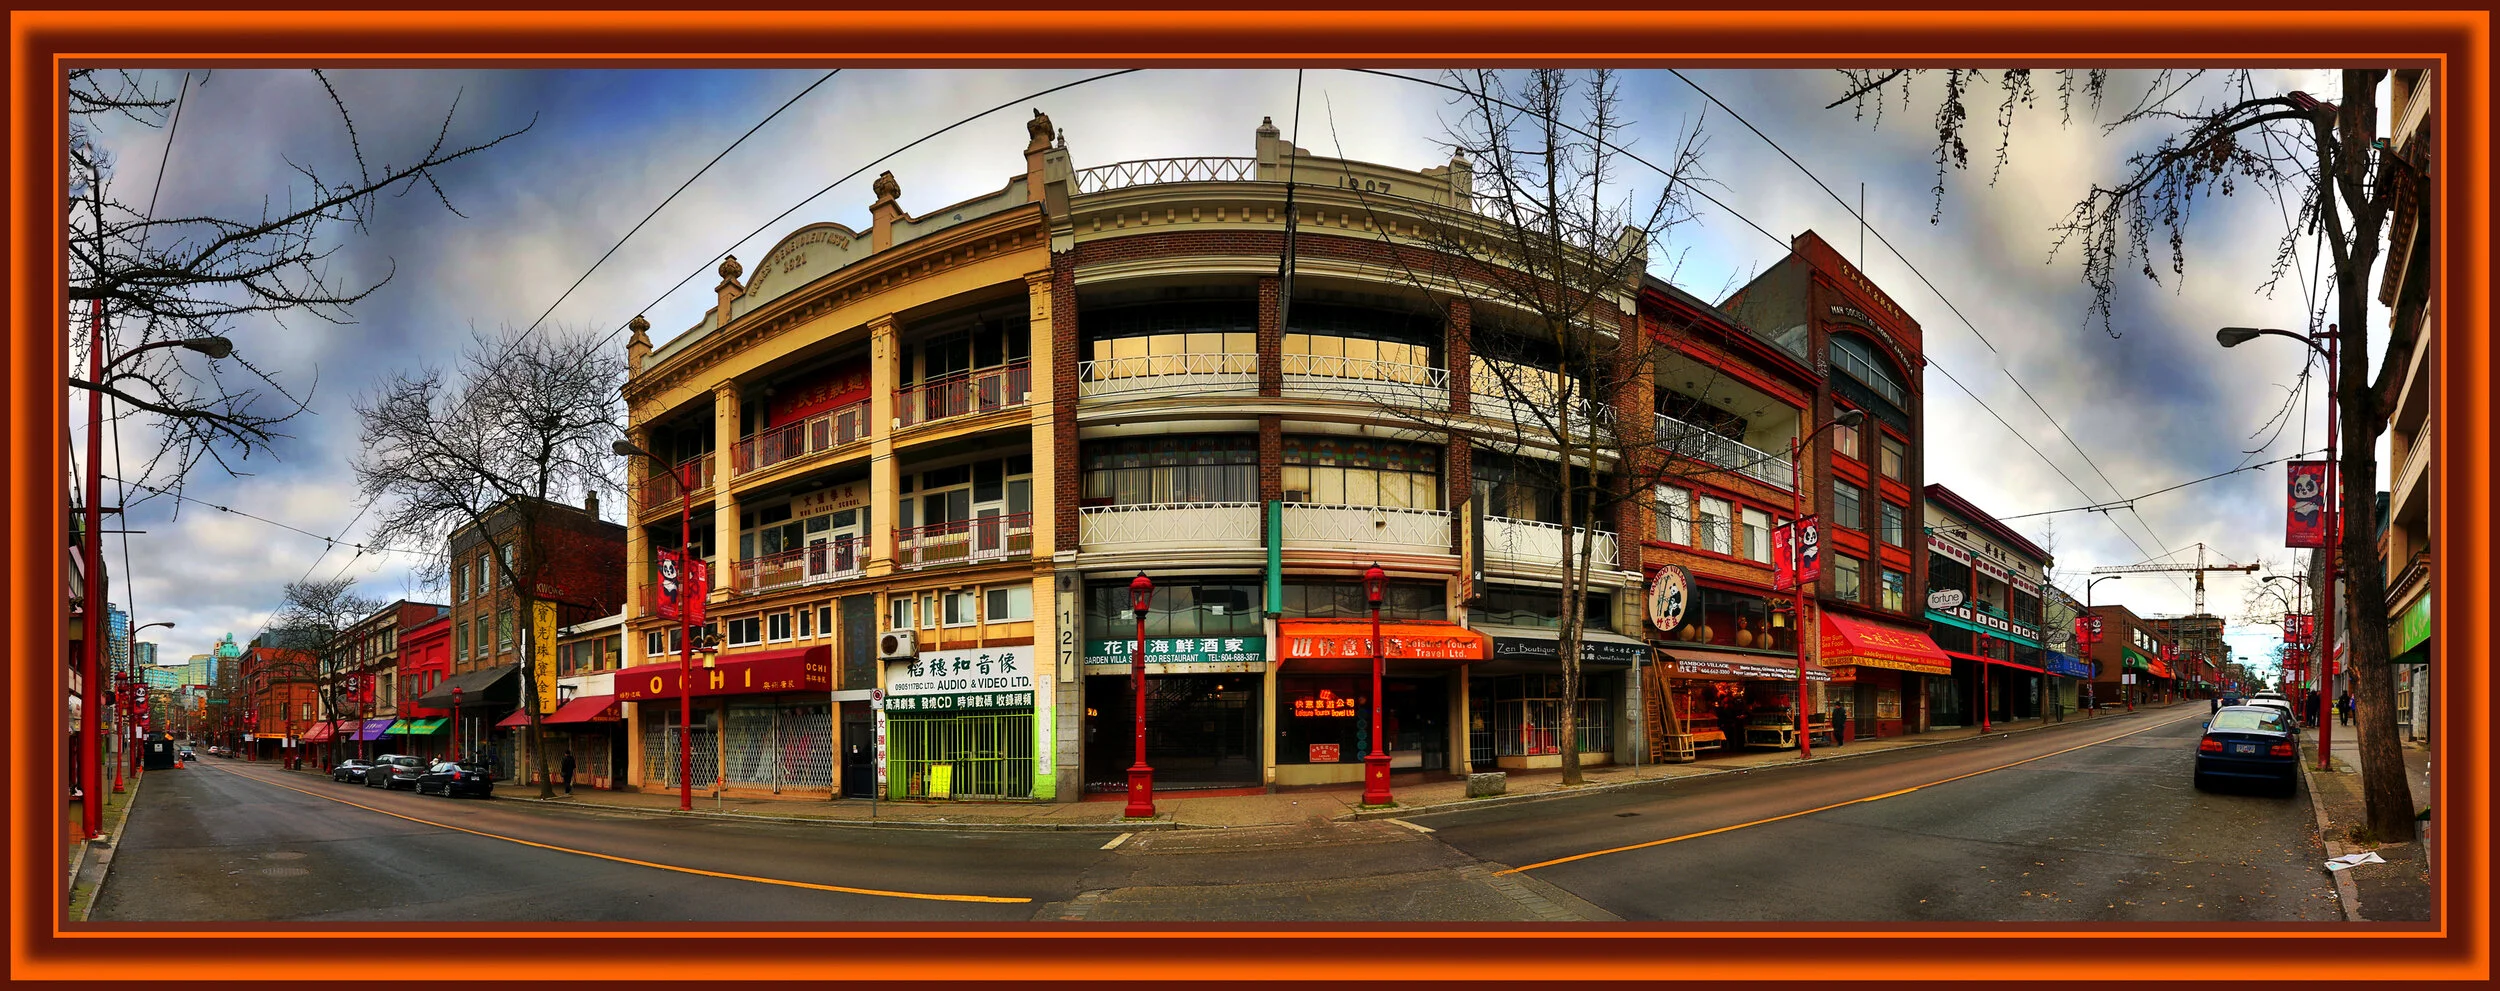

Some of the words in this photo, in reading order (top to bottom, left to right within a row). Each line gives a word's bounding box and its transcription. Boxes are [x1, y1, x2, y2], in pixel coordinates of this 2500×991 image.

[773, 232, 827, 265] BENEVOLENT
[783, 251, 807, 274] 1921
[1845, 307, 1868, 323] SOCIETY
[1868, 318, 1876, 328] OF
[1877, 325, 1893, 345] NORTH
[1893, 345, 1913, 376] AMERICA
[838, 498, 860, 509] SCHOOL
[1650, 566, 1669, 596] BAMBOO
[1670, 565, 1687, 591] VILLAGE
[1931, 593, 1959, 604] fortune
[1062, 610, 1073, 665] 127
[1415, 649, 1445, 658] Travel
[1449, 649, 1468, 658] Ltd.
[1497, 643, 1516, 654] Zen
[1519, 643, 1556, 656] Boutique
[1084, 656, 1109, 665] GARDEN
[1109, 655, 1127, 664] VILLA
[1128, 654, 1158, 664] SOOD
[1158, 653, 1199, 663] RESTAURANT
[806, 662, 828, 673] OCHI
[895, 682, 924, 691] 0905117BC
[924, 681, 936, 690] LTD.
[937, 678, 968, 691] AUDIO
[977, 677, 1008, 689] VIDEO
[1011, 676, 1032, 688] LTD.
[1295, 709, 1314, 717] Leisure
[1331, 709, 1346, 717] Travel
